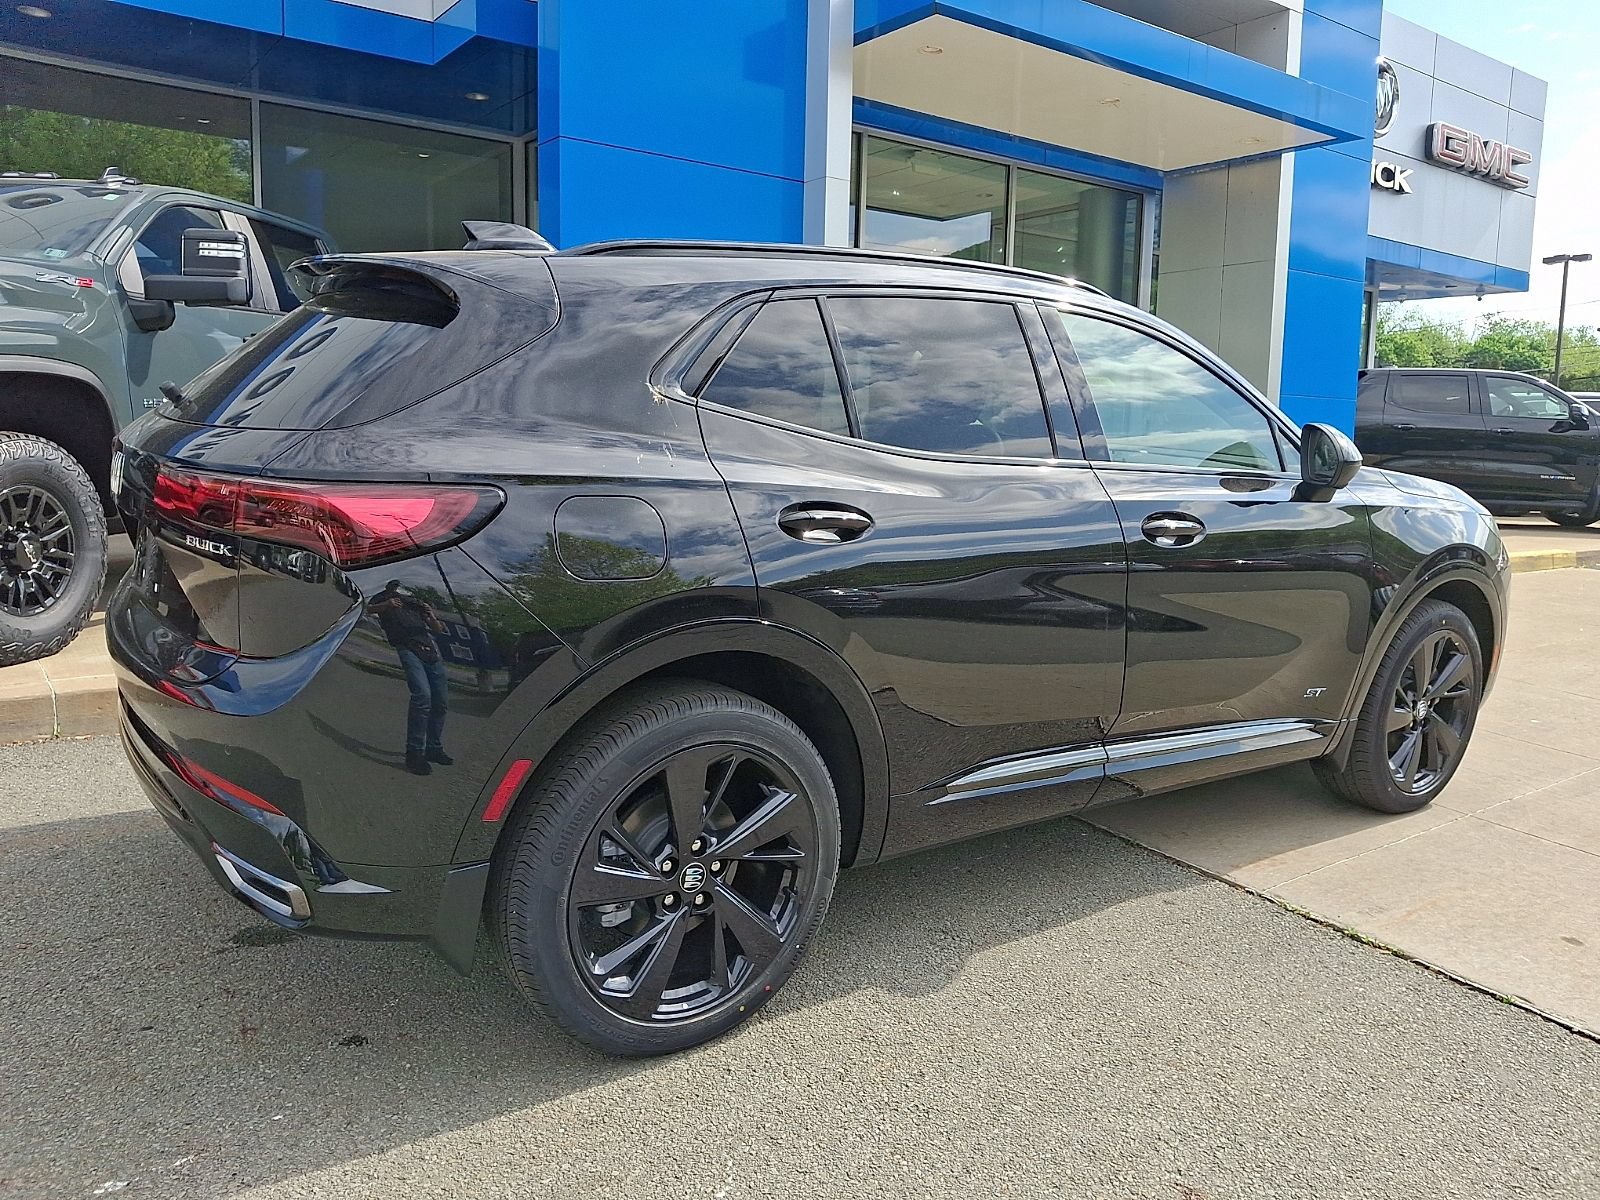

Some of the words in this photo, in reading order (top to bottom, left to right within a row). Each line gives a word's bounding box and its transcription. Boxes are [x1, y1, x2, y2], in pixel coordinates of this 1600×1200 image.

[1428, 121, 1533, 189] GMC
[185, 534, 233, 557] BUICK
[1303, 687, 1327, 698] ST
